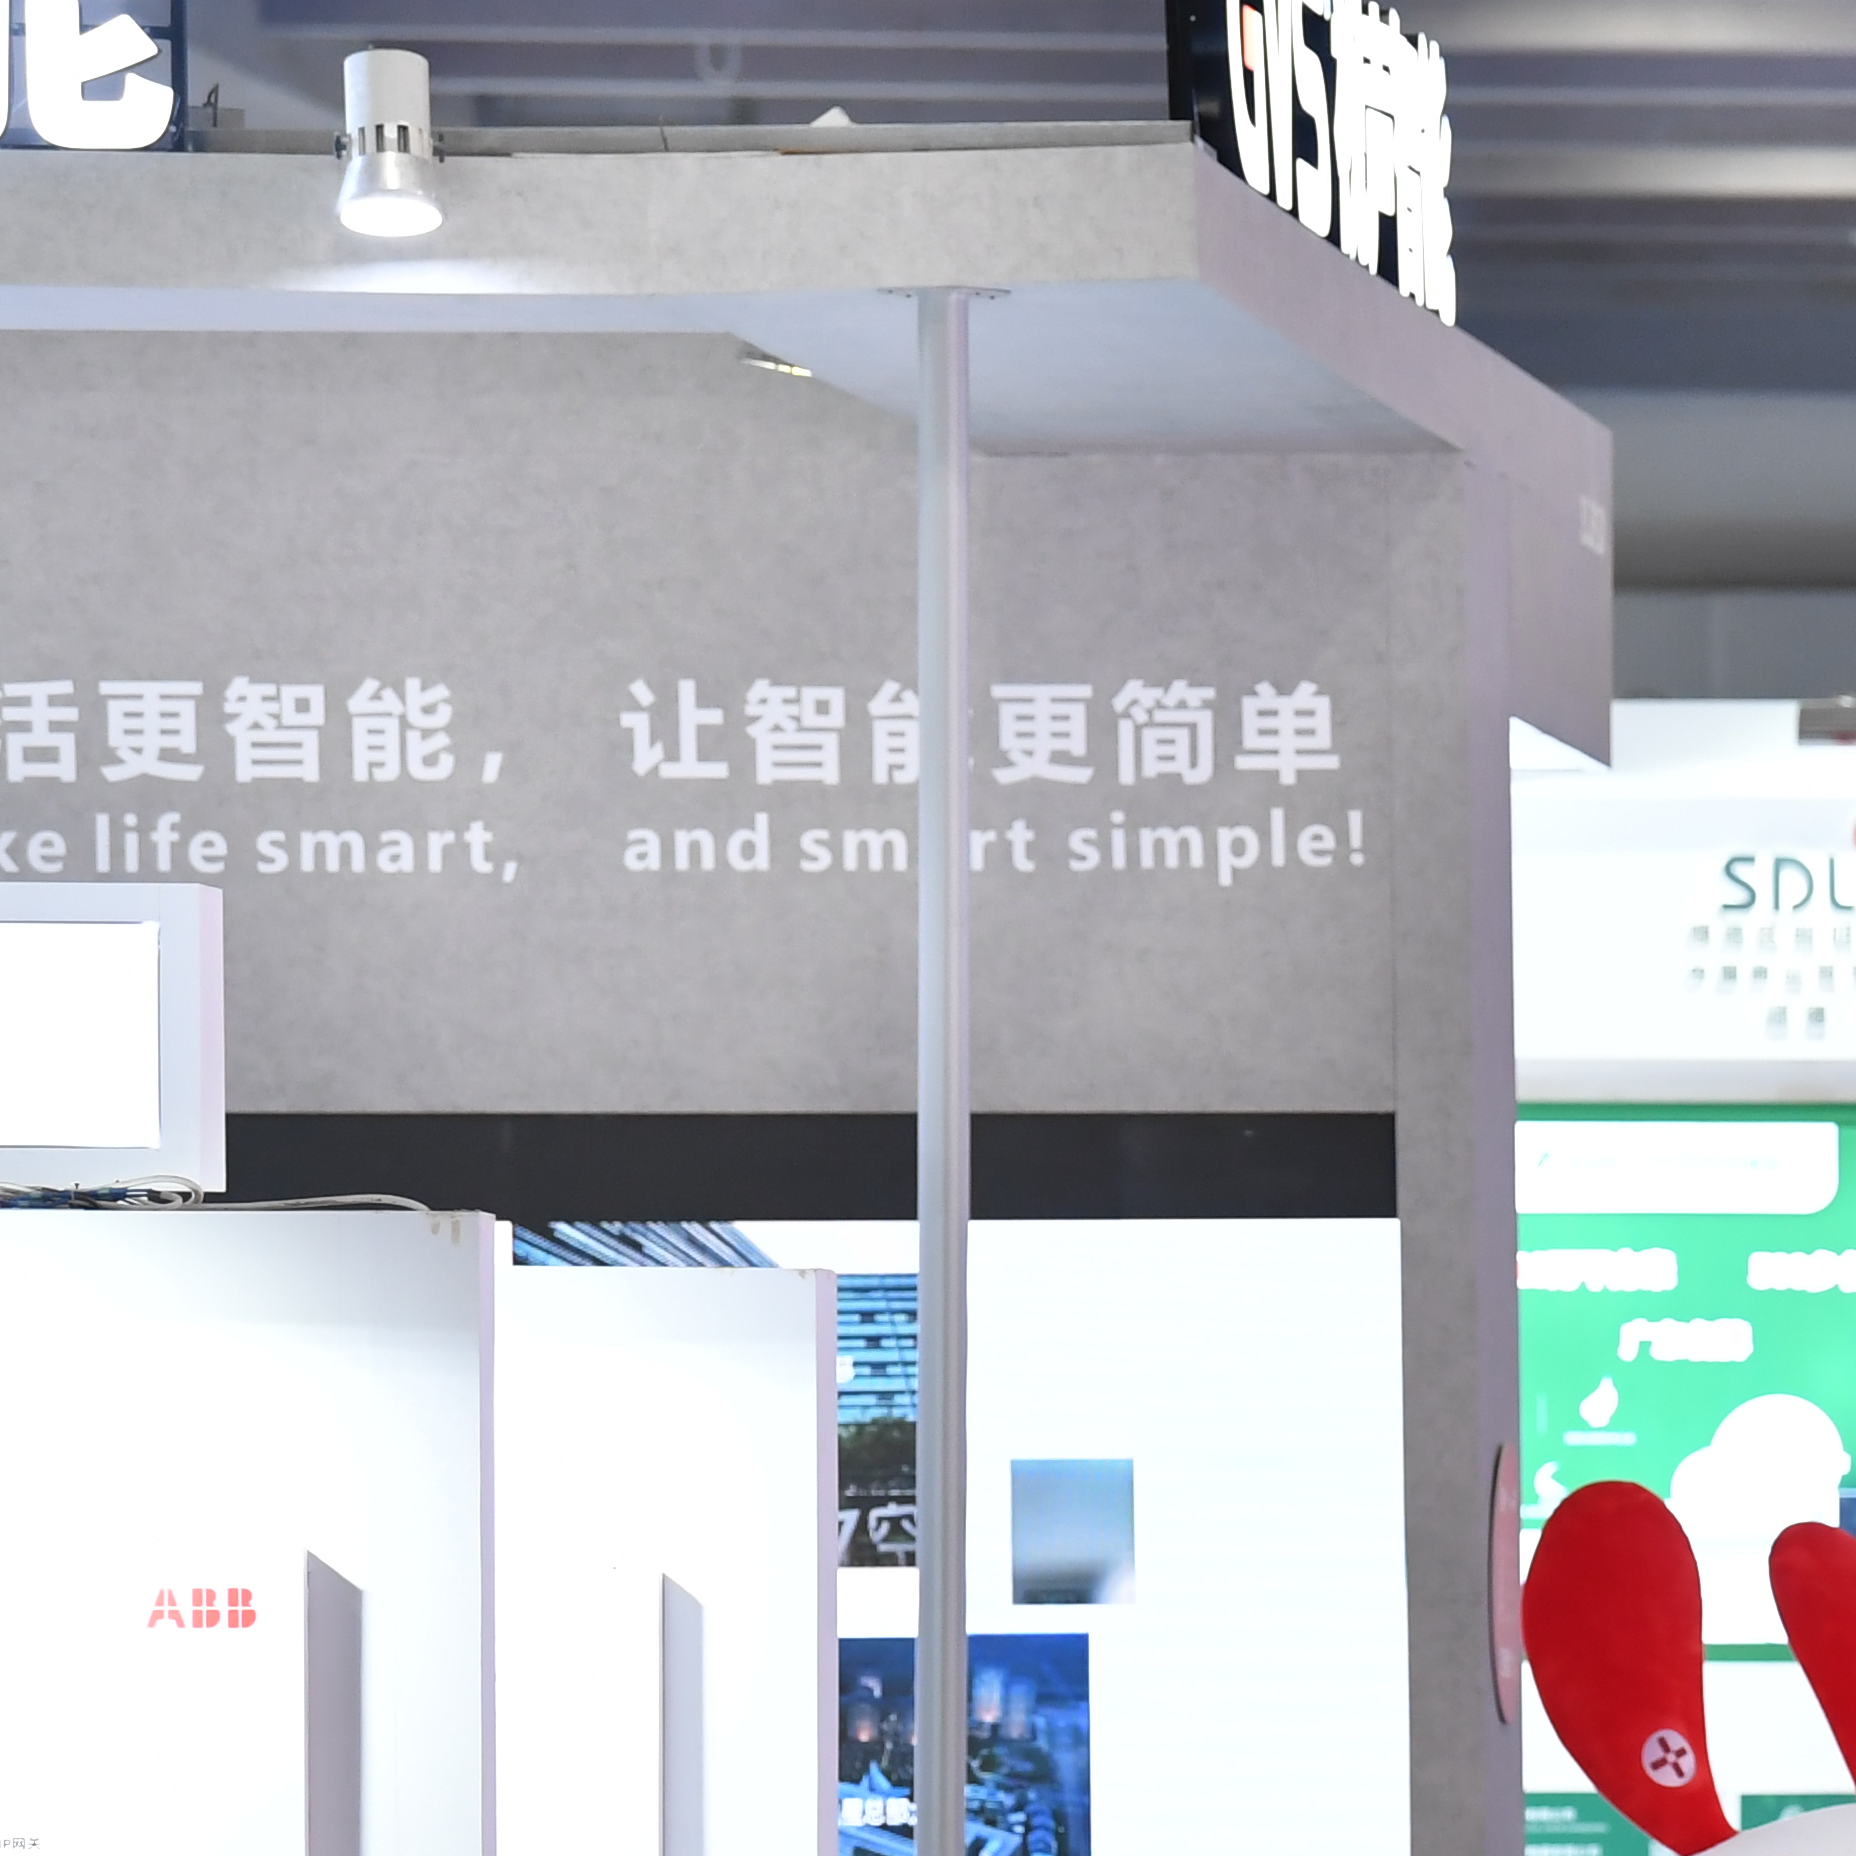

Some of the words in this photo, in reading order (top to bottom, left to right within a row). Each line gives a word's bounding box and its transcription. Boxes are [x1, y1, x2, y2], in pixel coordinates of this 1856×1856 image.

[94, 811, 229, 874] life
[255, 820, 518, 884] smart,
[622, 811, 772, 873] and
[799, 817, 1037, 873] smrt
[1068, 807, 1366, 887] simple!
[146, 1587, 258, 1629] ABB
